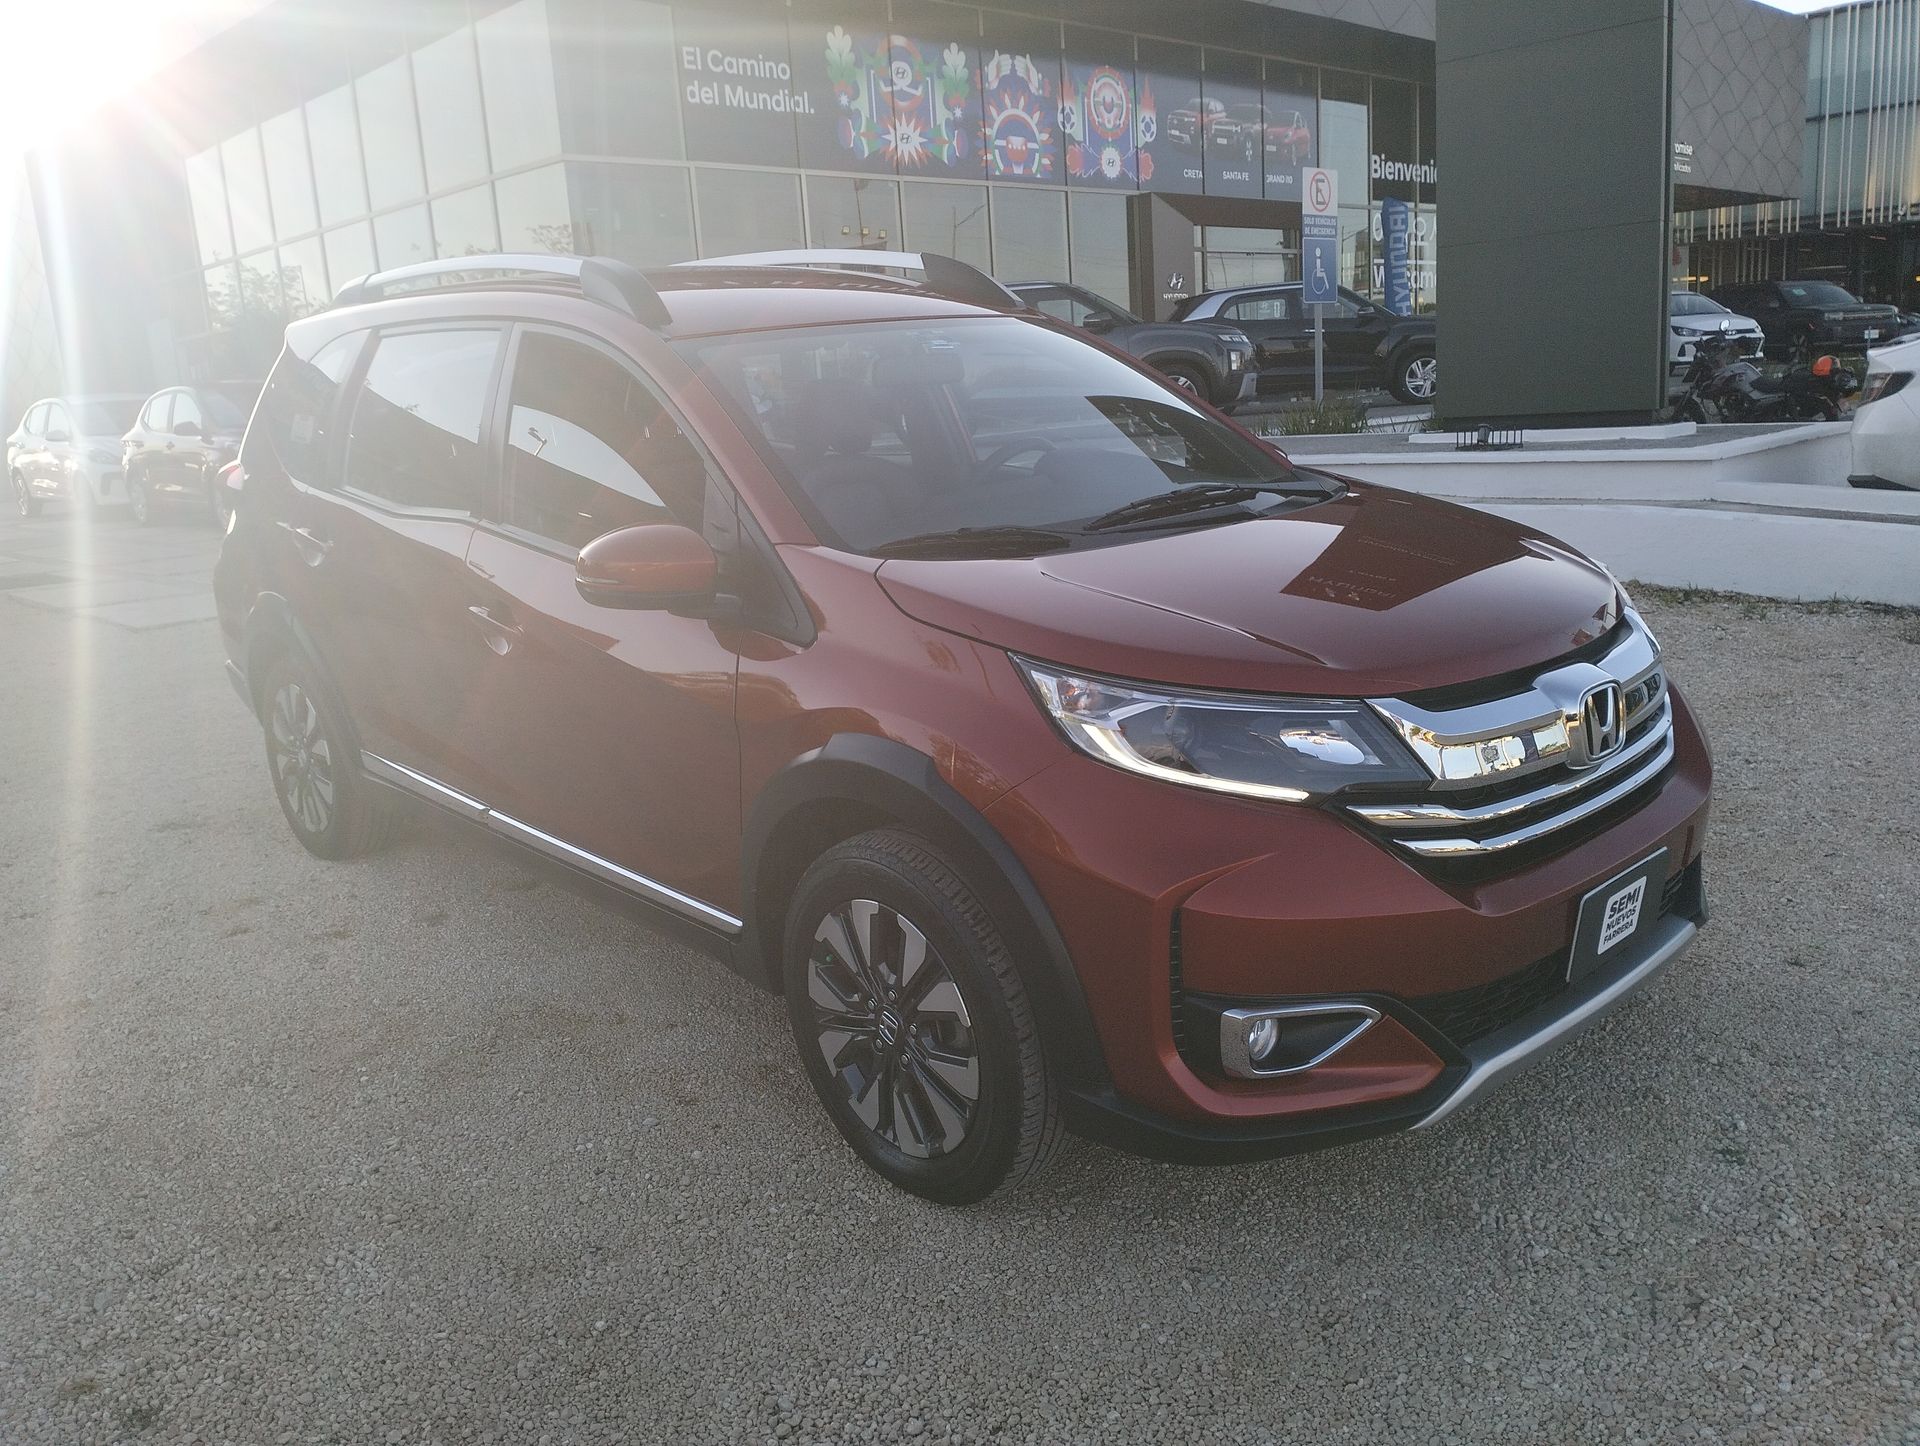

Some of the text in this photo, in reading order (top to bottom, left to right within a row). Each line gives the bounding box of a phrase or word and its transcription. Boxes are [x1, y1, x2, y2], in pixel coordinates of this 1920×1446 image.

[681, 46, 791, 80] El Camino
[686, 80, 815, 114] del Mundial.
[1183, 168, 1203, 179] CRETA
[1222, 170, 1250, 181] SANTA FE
[1607, 885, 1642, 919] SEMI
[1603, 919, 1634, 945] FARRERA
[1605, 905, 1637, 933] NUEVOS
